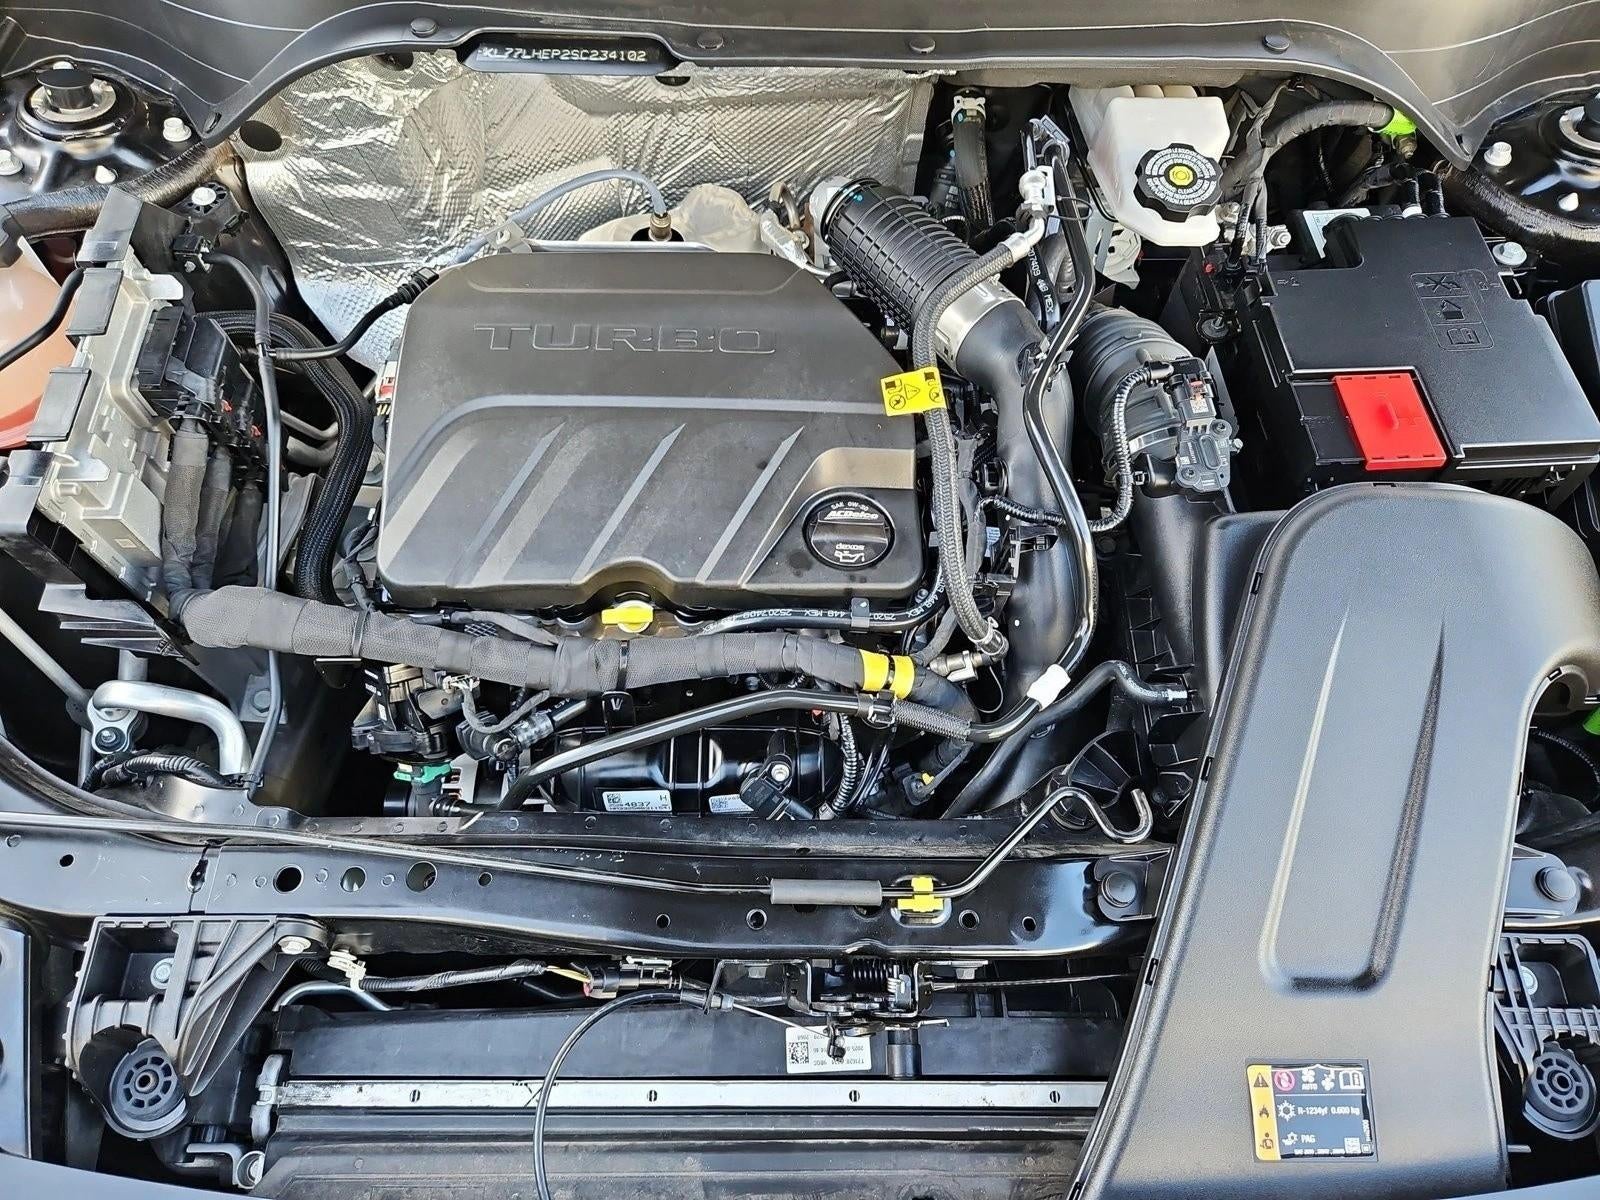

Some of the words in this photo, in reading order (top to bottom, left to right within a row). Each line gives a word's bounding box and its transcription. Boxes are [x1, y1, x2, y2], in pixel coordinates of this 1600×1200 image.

[1044, 295, 1054, 313] MEX
[474, 322, 777, 354] TURBO
[830, 501, 845, 510] SAE
[824, 510, 879, 521] ACDelco
[835, 543, 866, 551] dexos
[804, 608, 824, 617] MEX
[827, 608, 845, 617] 448
[906, 604, 925, 618] MEX
[1297, 1106, 1328, 1116] R-1234yf
[1351, 1106, 1361, 1116] kg
[1300, 1134, 1316, 1143] PAG
